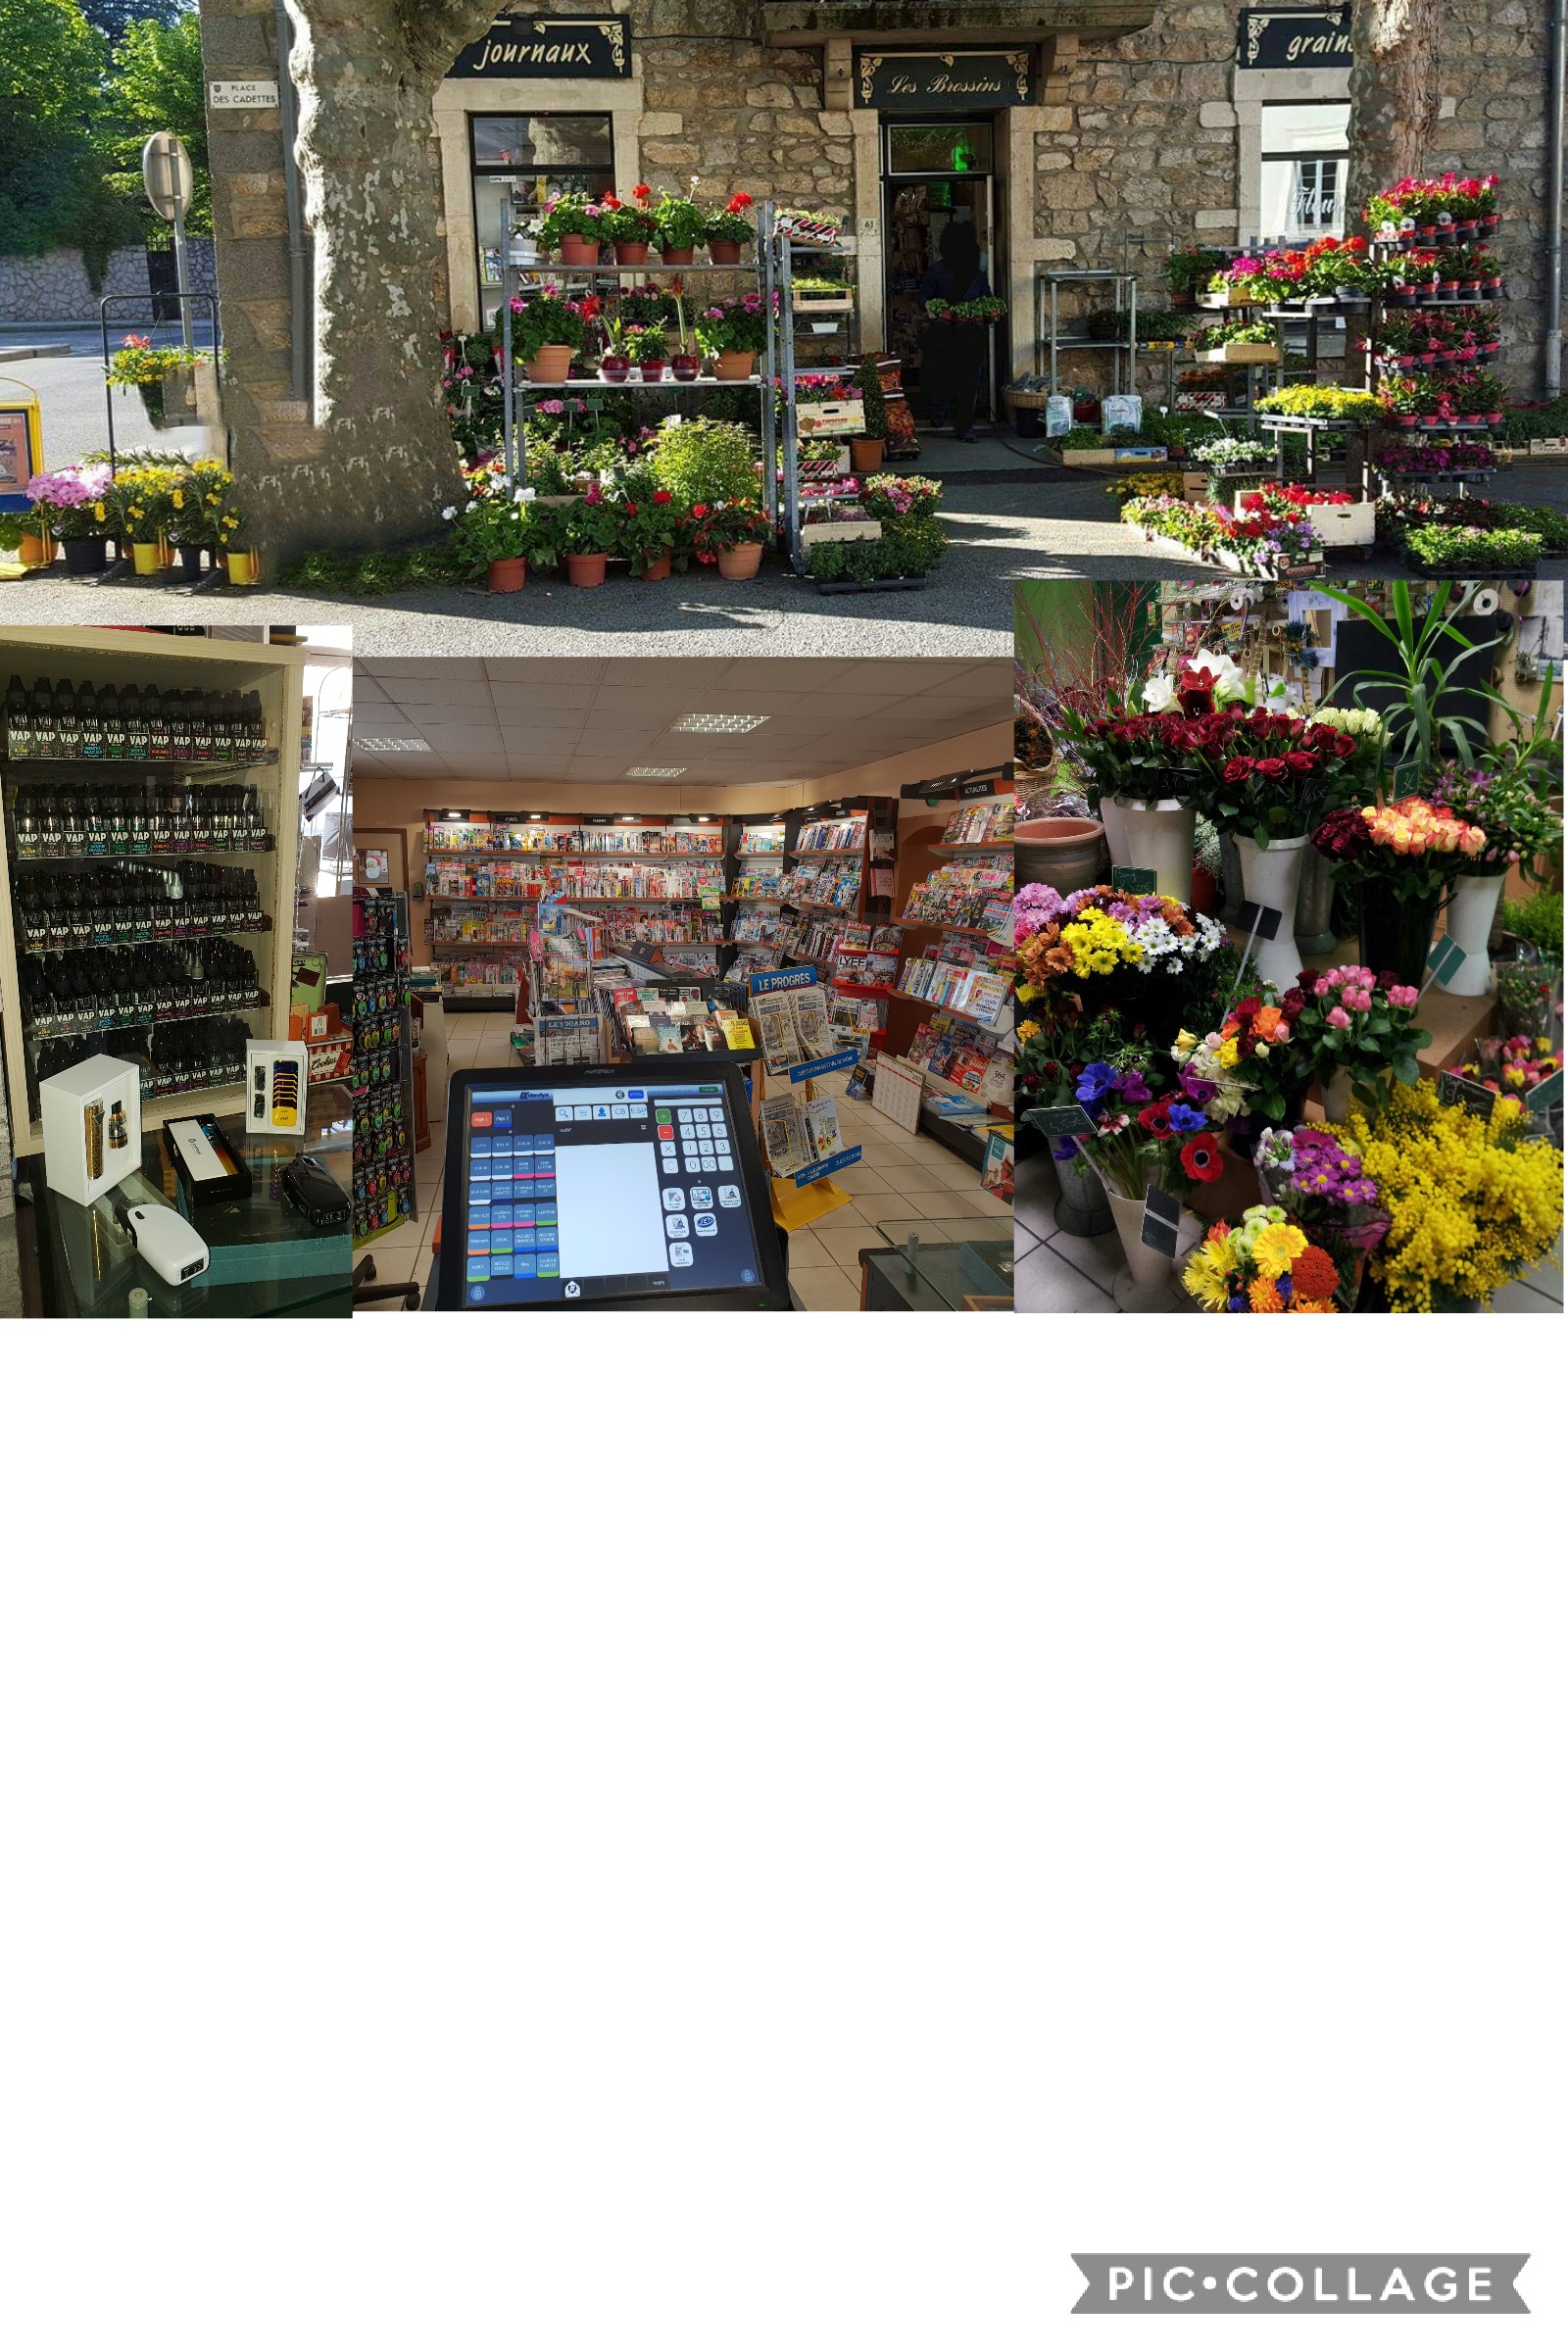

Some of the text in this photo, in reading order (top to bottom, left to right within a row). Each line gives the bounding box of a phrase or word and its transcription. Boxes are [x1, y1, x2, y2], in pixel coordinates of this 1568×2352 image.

[473, 39, 591, 71] journaux
[887, 74, 1001, 94] Les Brossins
[10, 730, 268, 749] VAP VAP VAP VAP VAP VAP VAP VAP VAP VAP VAP VAP
[19, 828, 267, 843] VAP VAP VAP VAP VAP VAP VAP VAP VAP VAP VAP VAP
[26, 911, 263, 938] VAP VAP VAP VAP VAP VAP VAP VAP VAP VAP VAP VAP
[759, 978, 769, 991] LE
[34, 1016, 53, 1025] VAP
[56, 1012, 74, 1023] VAP
[77, 1011, 94, 1021] VAP
[98, 1008, 115, 1017] VAP
[118, 1005, 134, 1014] VAP
[137, 1004, 153, 1012] VAP
[157, 1001, 172, 1010] VAP
[174, 999, 190, 1007] VAP
[193, 997, 208, 1005] VAP
[211, 994, 225, 1004] VAP
[227, 992, 242, 1002] VAP
[245, 990, 259, 999] VAP
[157, 1076, 172, 1086] VAP
[174, 1073, 189, 1082] VAP
[191, 1070, 206, 1079] VAP
[209, 1068, 223, 1077] VAP
[225, 1065, 240, 1074] VAP
[698, 1110, 703, 1119] 8
[712, 1110, 719, 1119] 9
[684, 1126, 723, 1136] 4 5 6
[703, 1143, 710, 1152] 2
[719, 1142, 726, 1151] 3
[689, 1159, 715, 1169] 0 00
